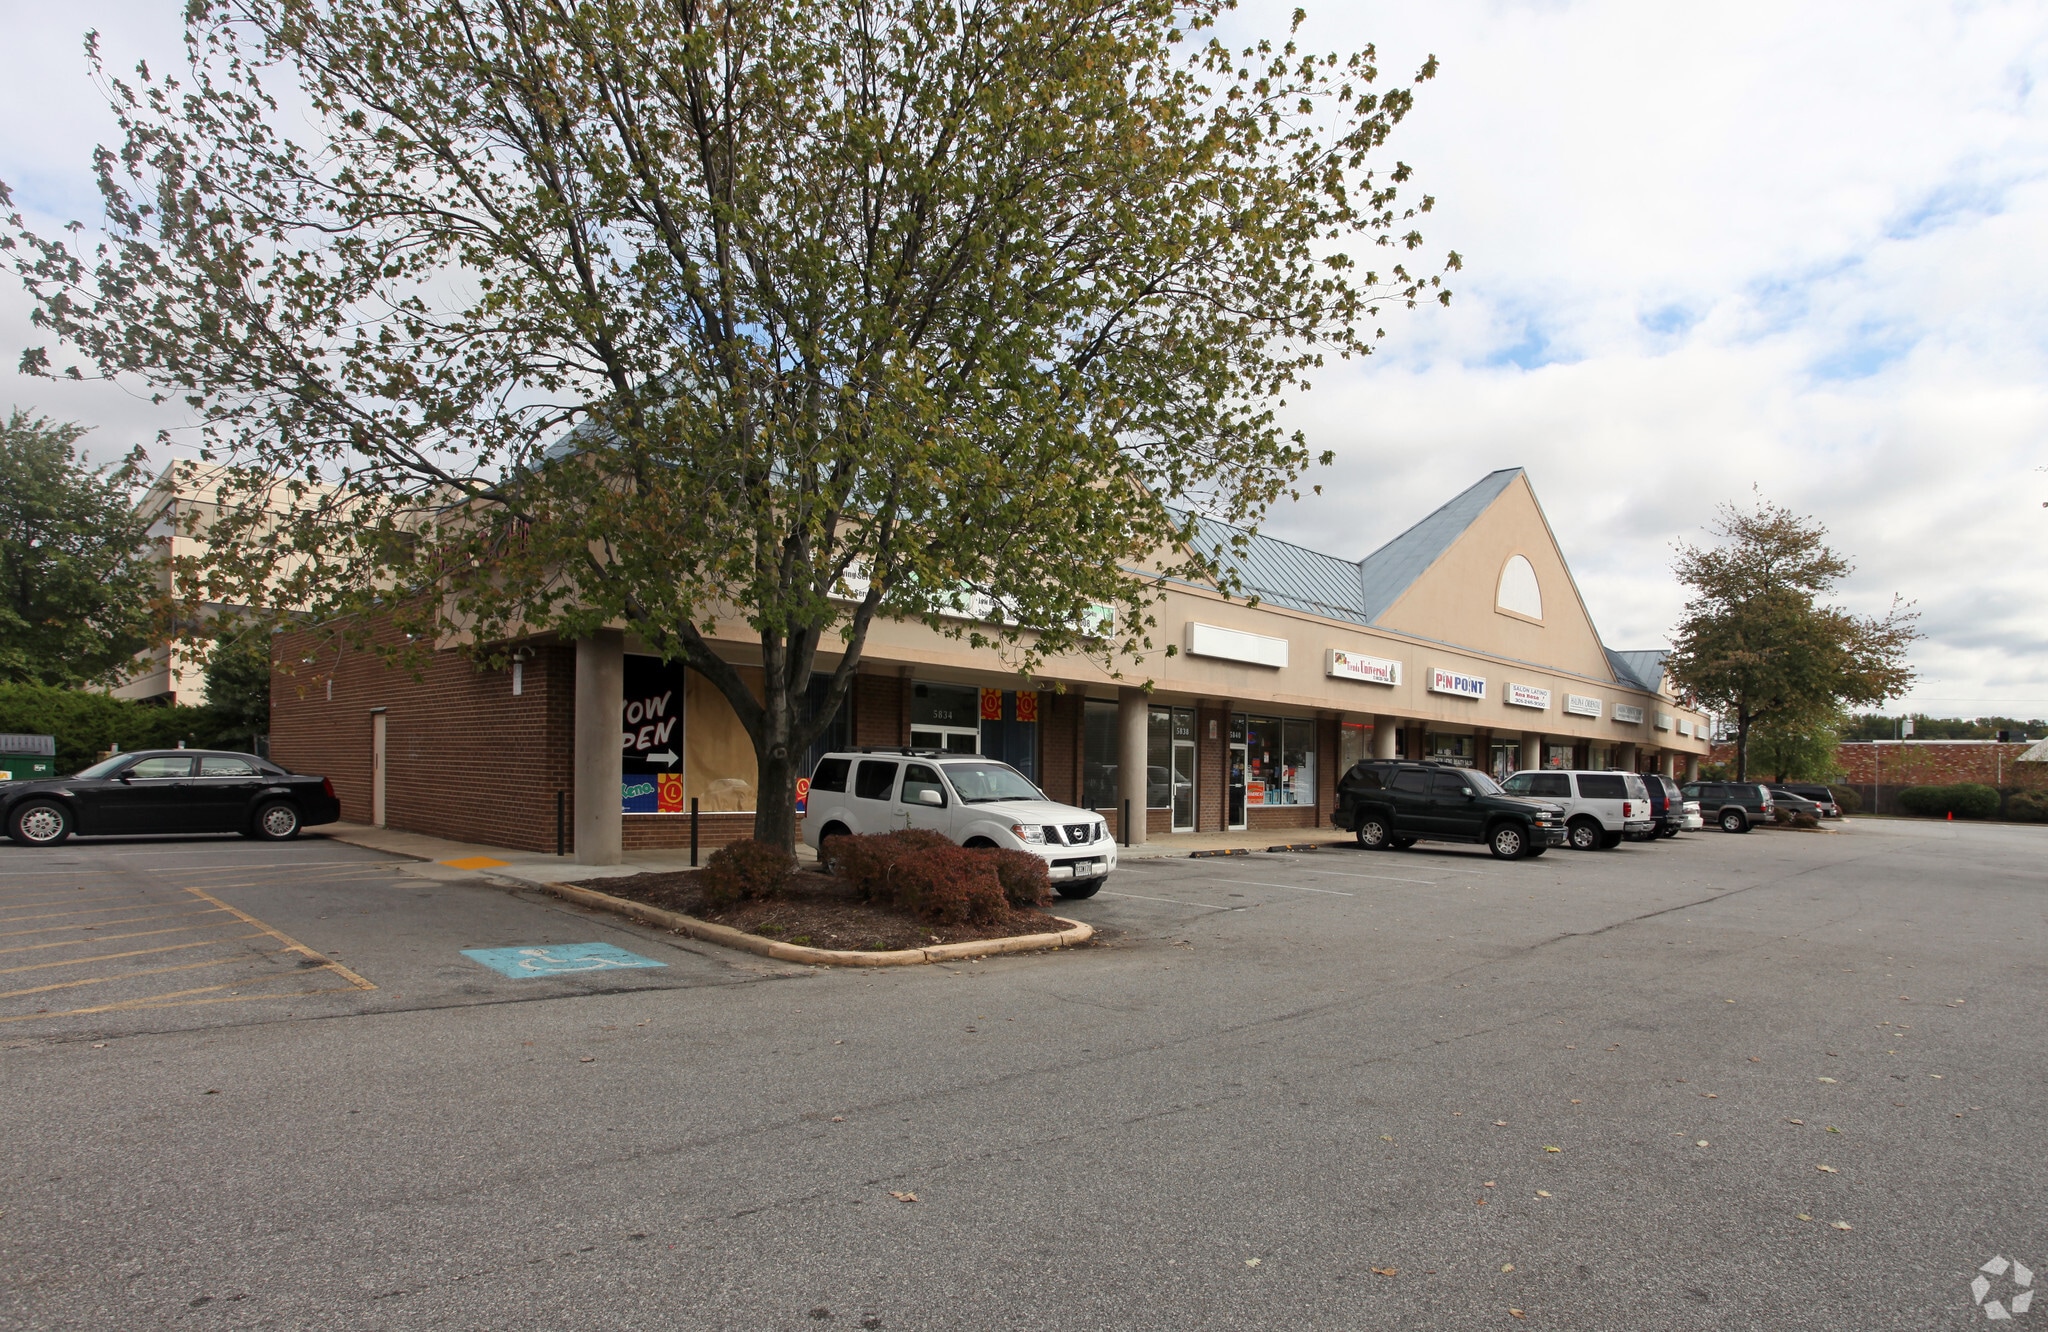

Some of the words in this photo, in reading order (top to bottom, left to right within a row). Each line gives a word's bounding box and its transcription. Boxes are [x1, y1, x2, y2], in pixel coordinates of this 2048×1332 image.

[1360, 660, 1388, 678] Universal
[1513, 685, 1530, 693] SALON
[1530, 688, 1548, 696] LATINO
[623, 690, 672, 724] OW
[932, 709, 953, 720] 5834
[623, 716, 677, 750] PEN
[670, 787, 677, 797] L
